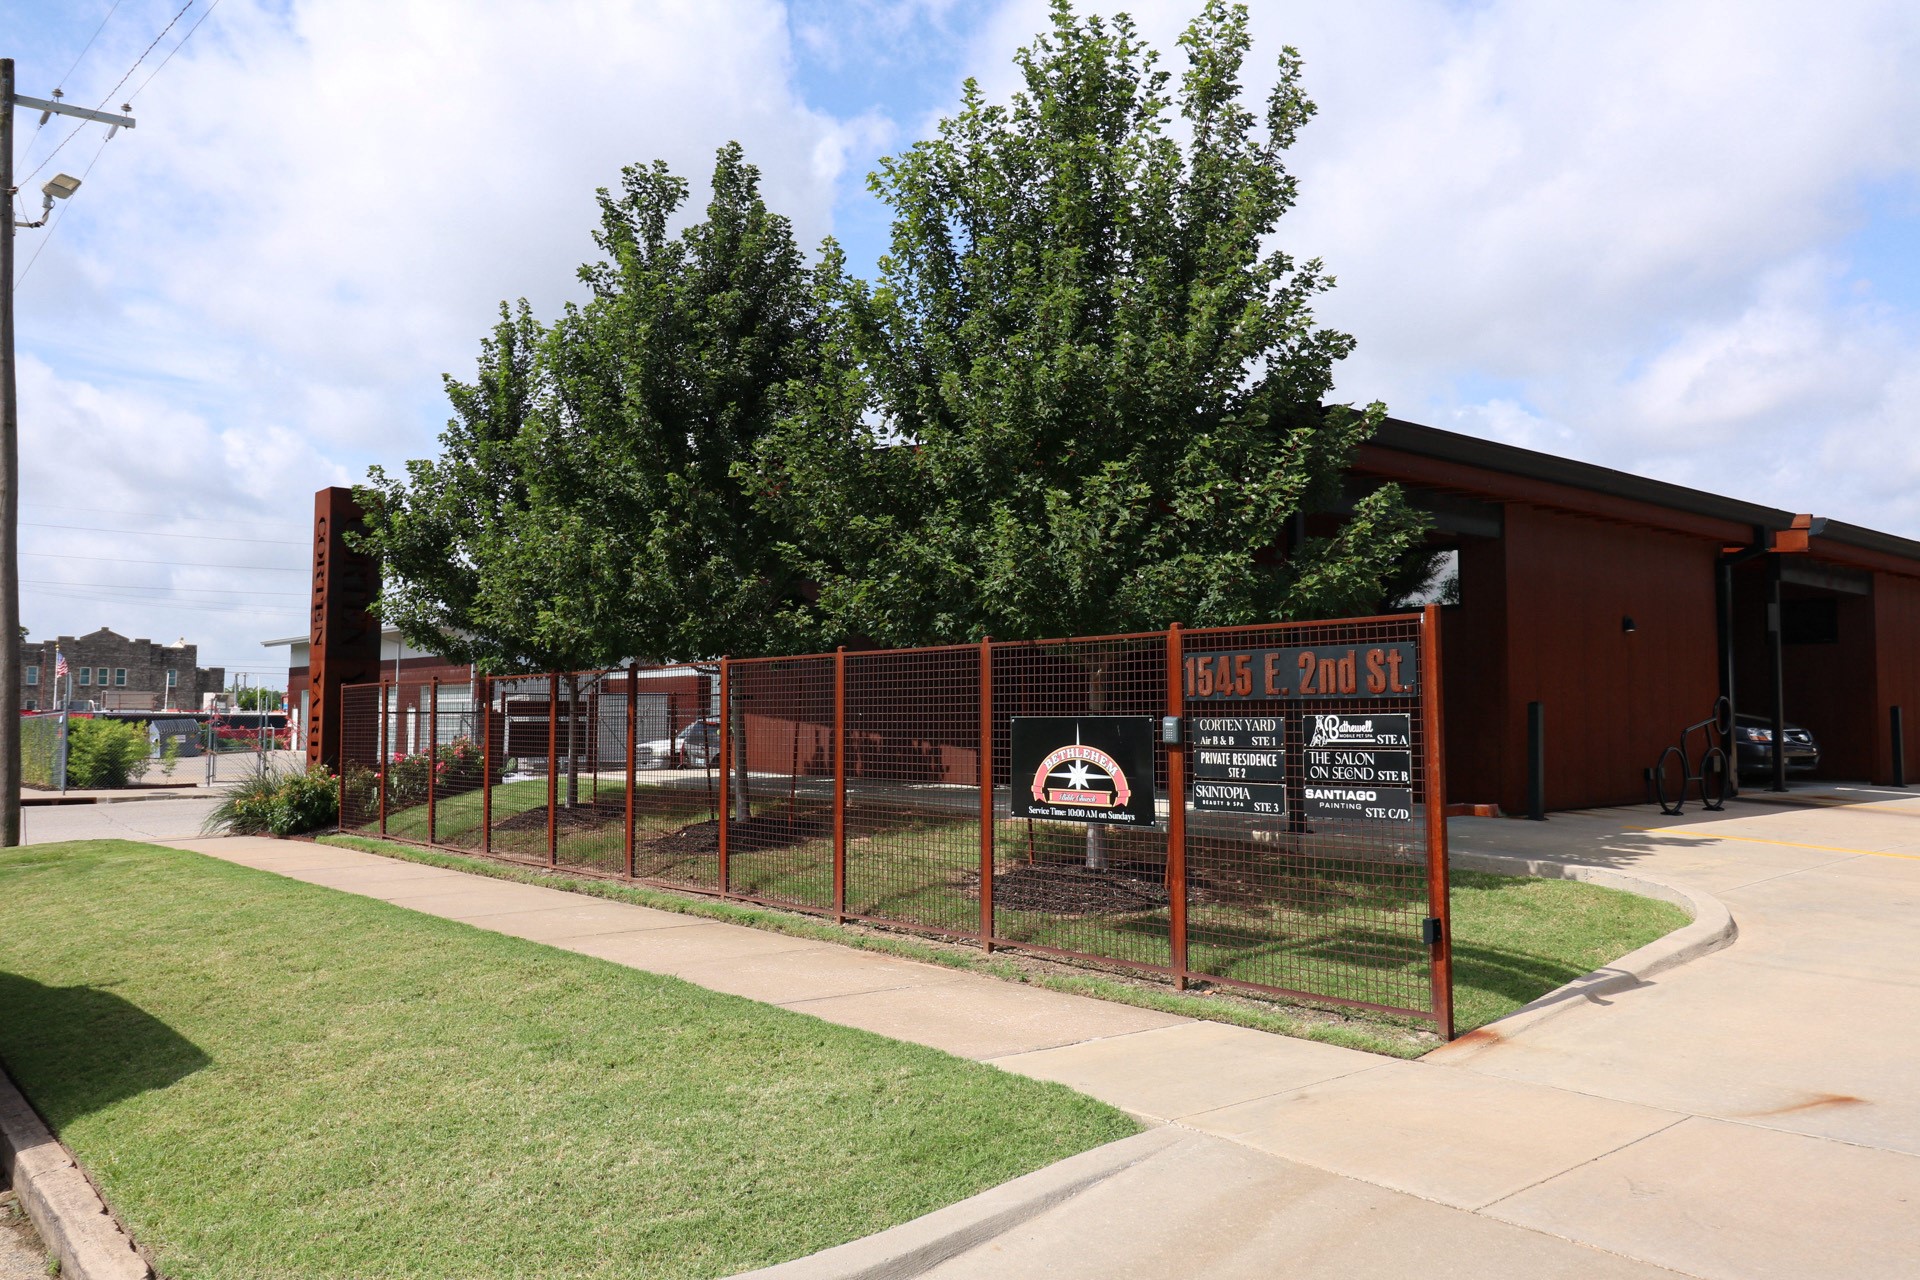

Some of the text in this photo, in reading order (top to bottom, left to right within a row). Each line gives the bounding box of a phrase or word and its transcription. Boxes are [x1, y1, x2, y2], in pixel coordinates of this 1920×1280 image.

[311, 517, 326, 762] CORTEN YARD
[1185, 648, 1413, 697] 1545 E. 2nd St.
[1200, 719, 1276, 732] CORTEN YARD
[1324, 715, 1374, 740] Bathewell
[1200, 736, 1235, 746] Air B & B
[1251, 736, 1277, 746] STE 1
[1377, 735, 1408, 745] STE A
[1044, 748, 1119, 776] BETHLEHEM
[1200, 752, 1277, 767] PRIVATE RESIDENCE
[1309, 752, 1375, 765] THE SALON
[1228, 767, 1246, 778] STE 2
[1310, 766, 1329, 779] ON
[1377, 771, 1409, 782] STE B
[1195, 785, 1251, 800] SKINTOPIA
[1305, 789, 1377, 802] SANTIAGO
[1254, 802, 1279, 812] STE 3
[1319, 802, 1362, 810] PAINTING
[1028, 806, 1049, 815] Service
[1050, 807, 1067, 816] Time:
[1067, 808, 1085, 818] 10:00
[1086, 810, 1098, 818] AM
[1107, 811, 1136, 823] Sundays
[1365, 808, 1409, 820] STE C/D
